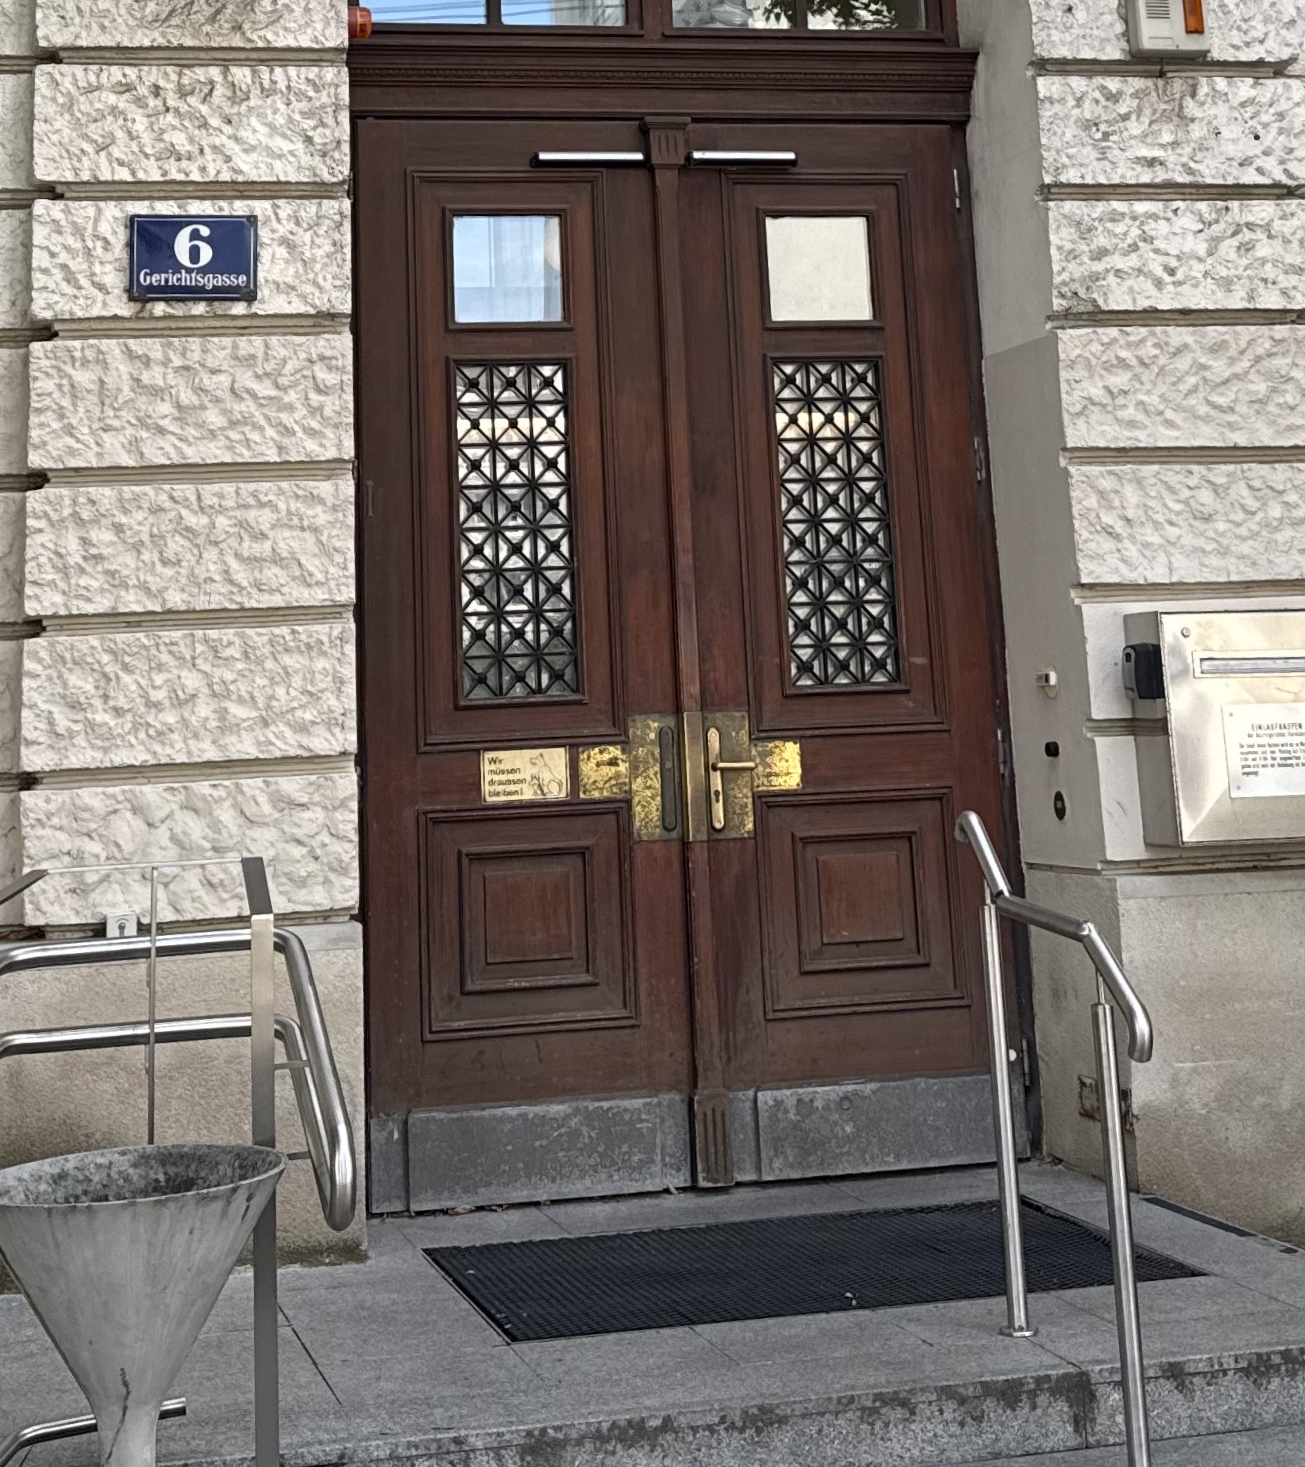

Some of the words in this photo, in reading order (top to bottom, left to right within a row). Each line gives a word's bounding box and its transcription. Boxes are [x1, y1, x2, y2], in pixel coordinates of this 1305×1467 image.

[174, 224, 213, 268] 6
[139, 268, 247, 290] Gerichtsgasse
[487, 756, 503, 765] Wir
